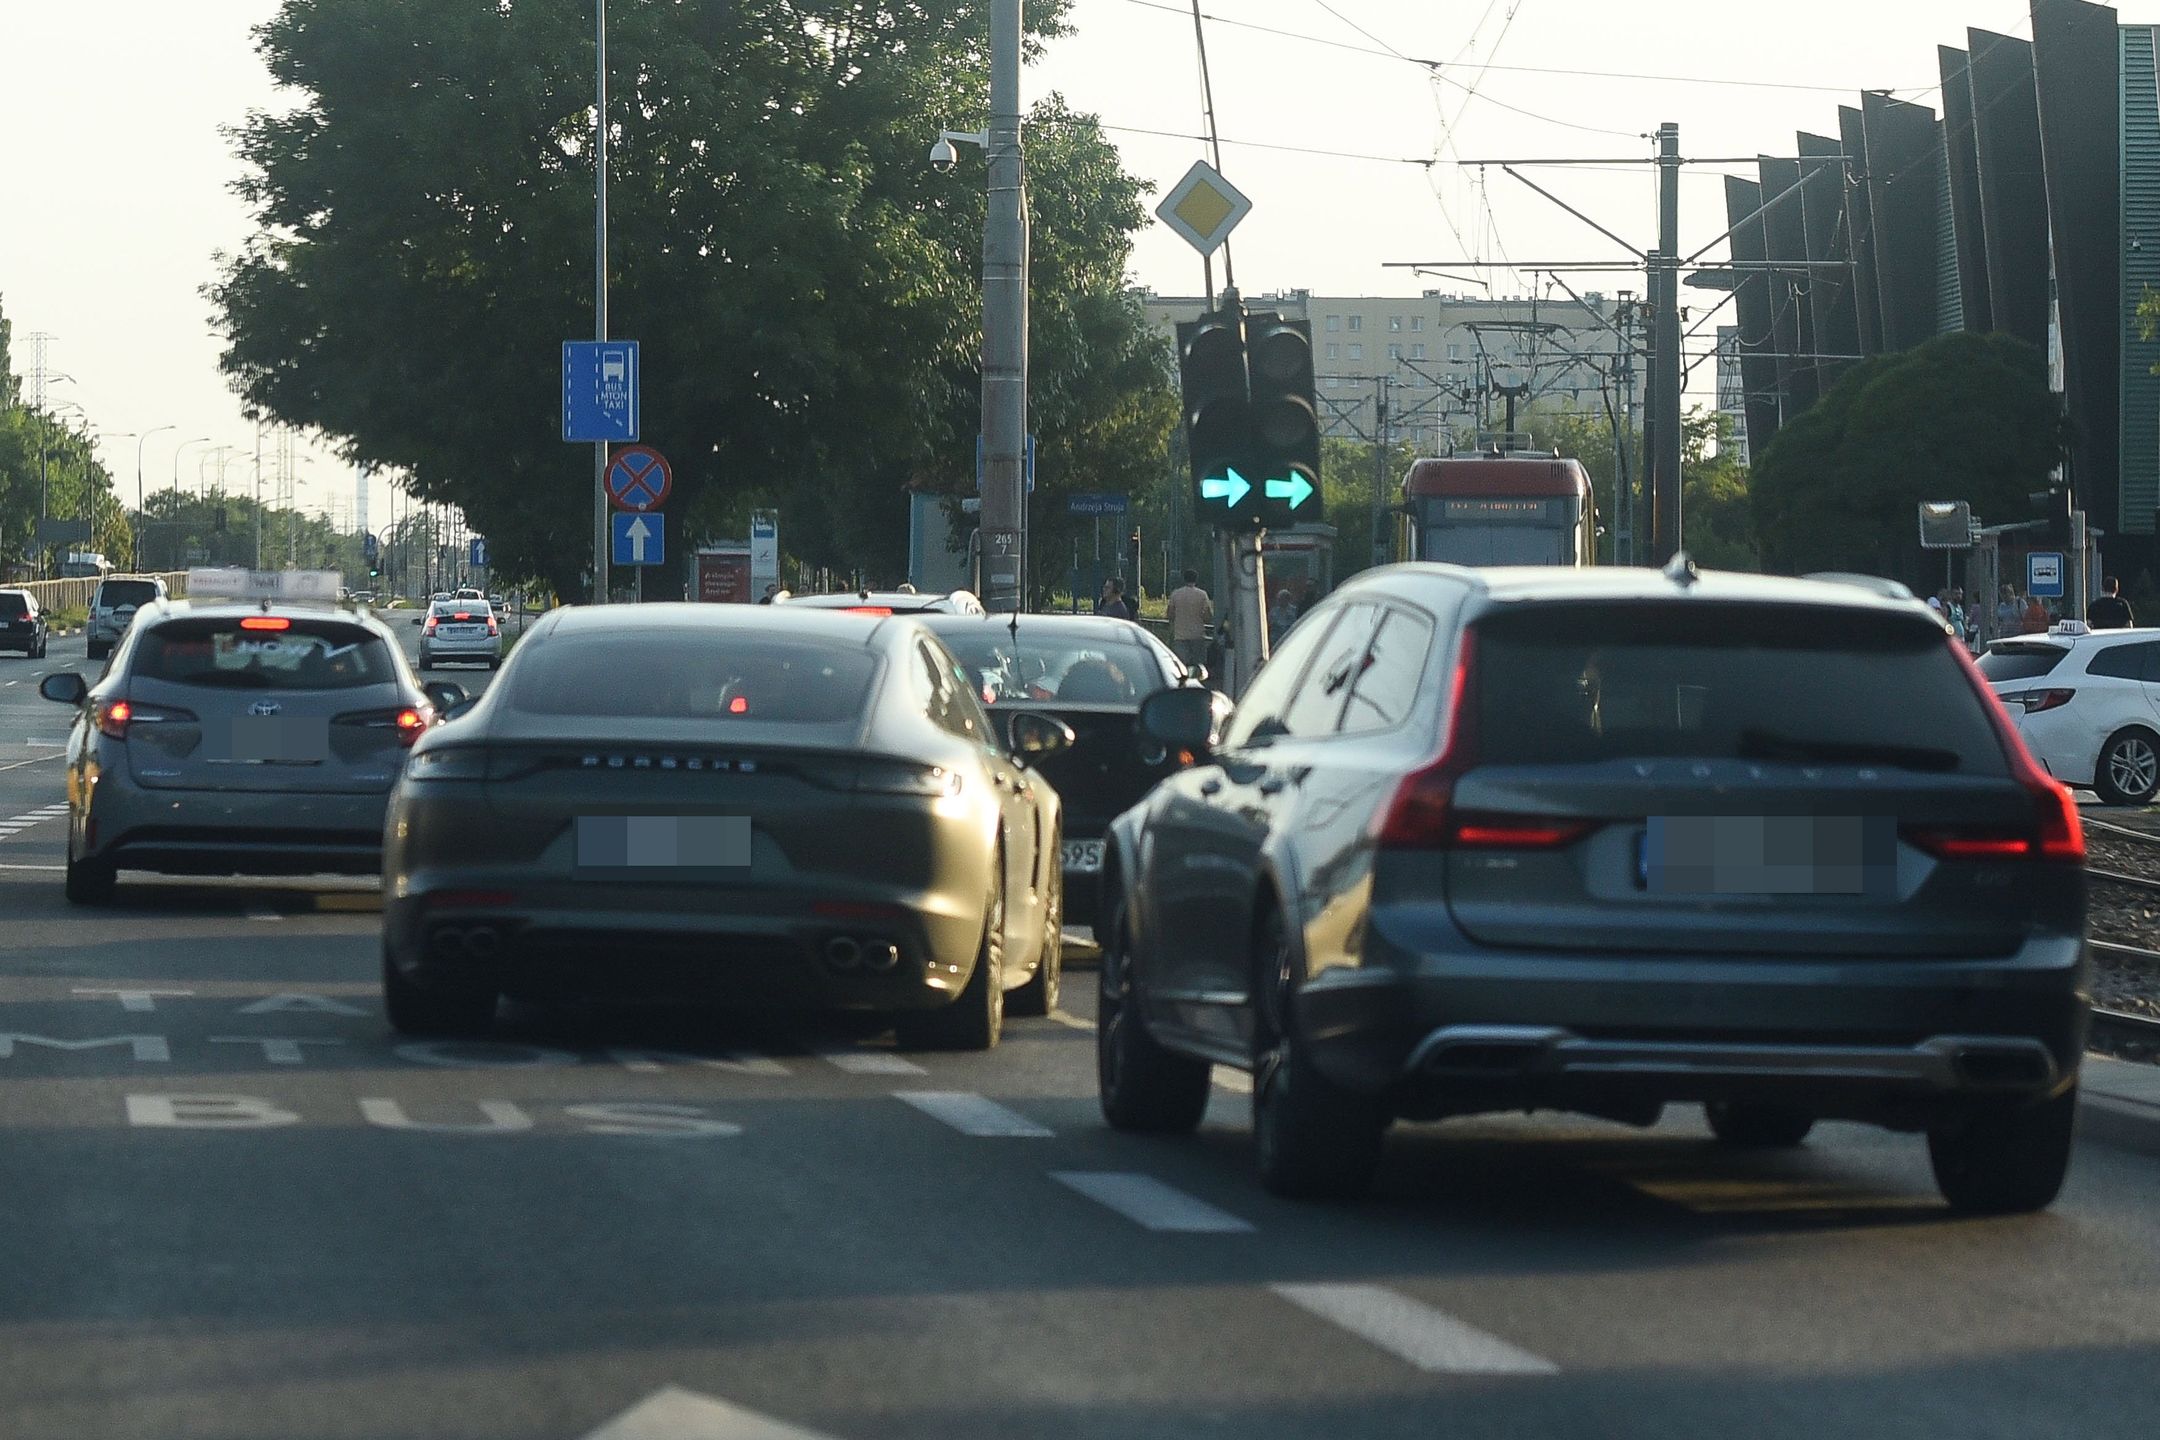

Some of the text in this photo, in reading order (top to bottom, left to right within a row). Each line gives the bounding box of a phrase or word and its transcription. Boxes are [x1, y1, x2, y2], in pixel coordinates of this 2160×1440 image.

[605, 383, 622, 391] BUS
[600, 391, 627, 401] MTON
[604, 401, 624, 410] TAXI
[995, 533, 1012, 545] 265
[1001, 544, 1007, 555] 7
[2060, 622, 2076, 632] TAXI
[126, 1093, 744, 1138] BUS
